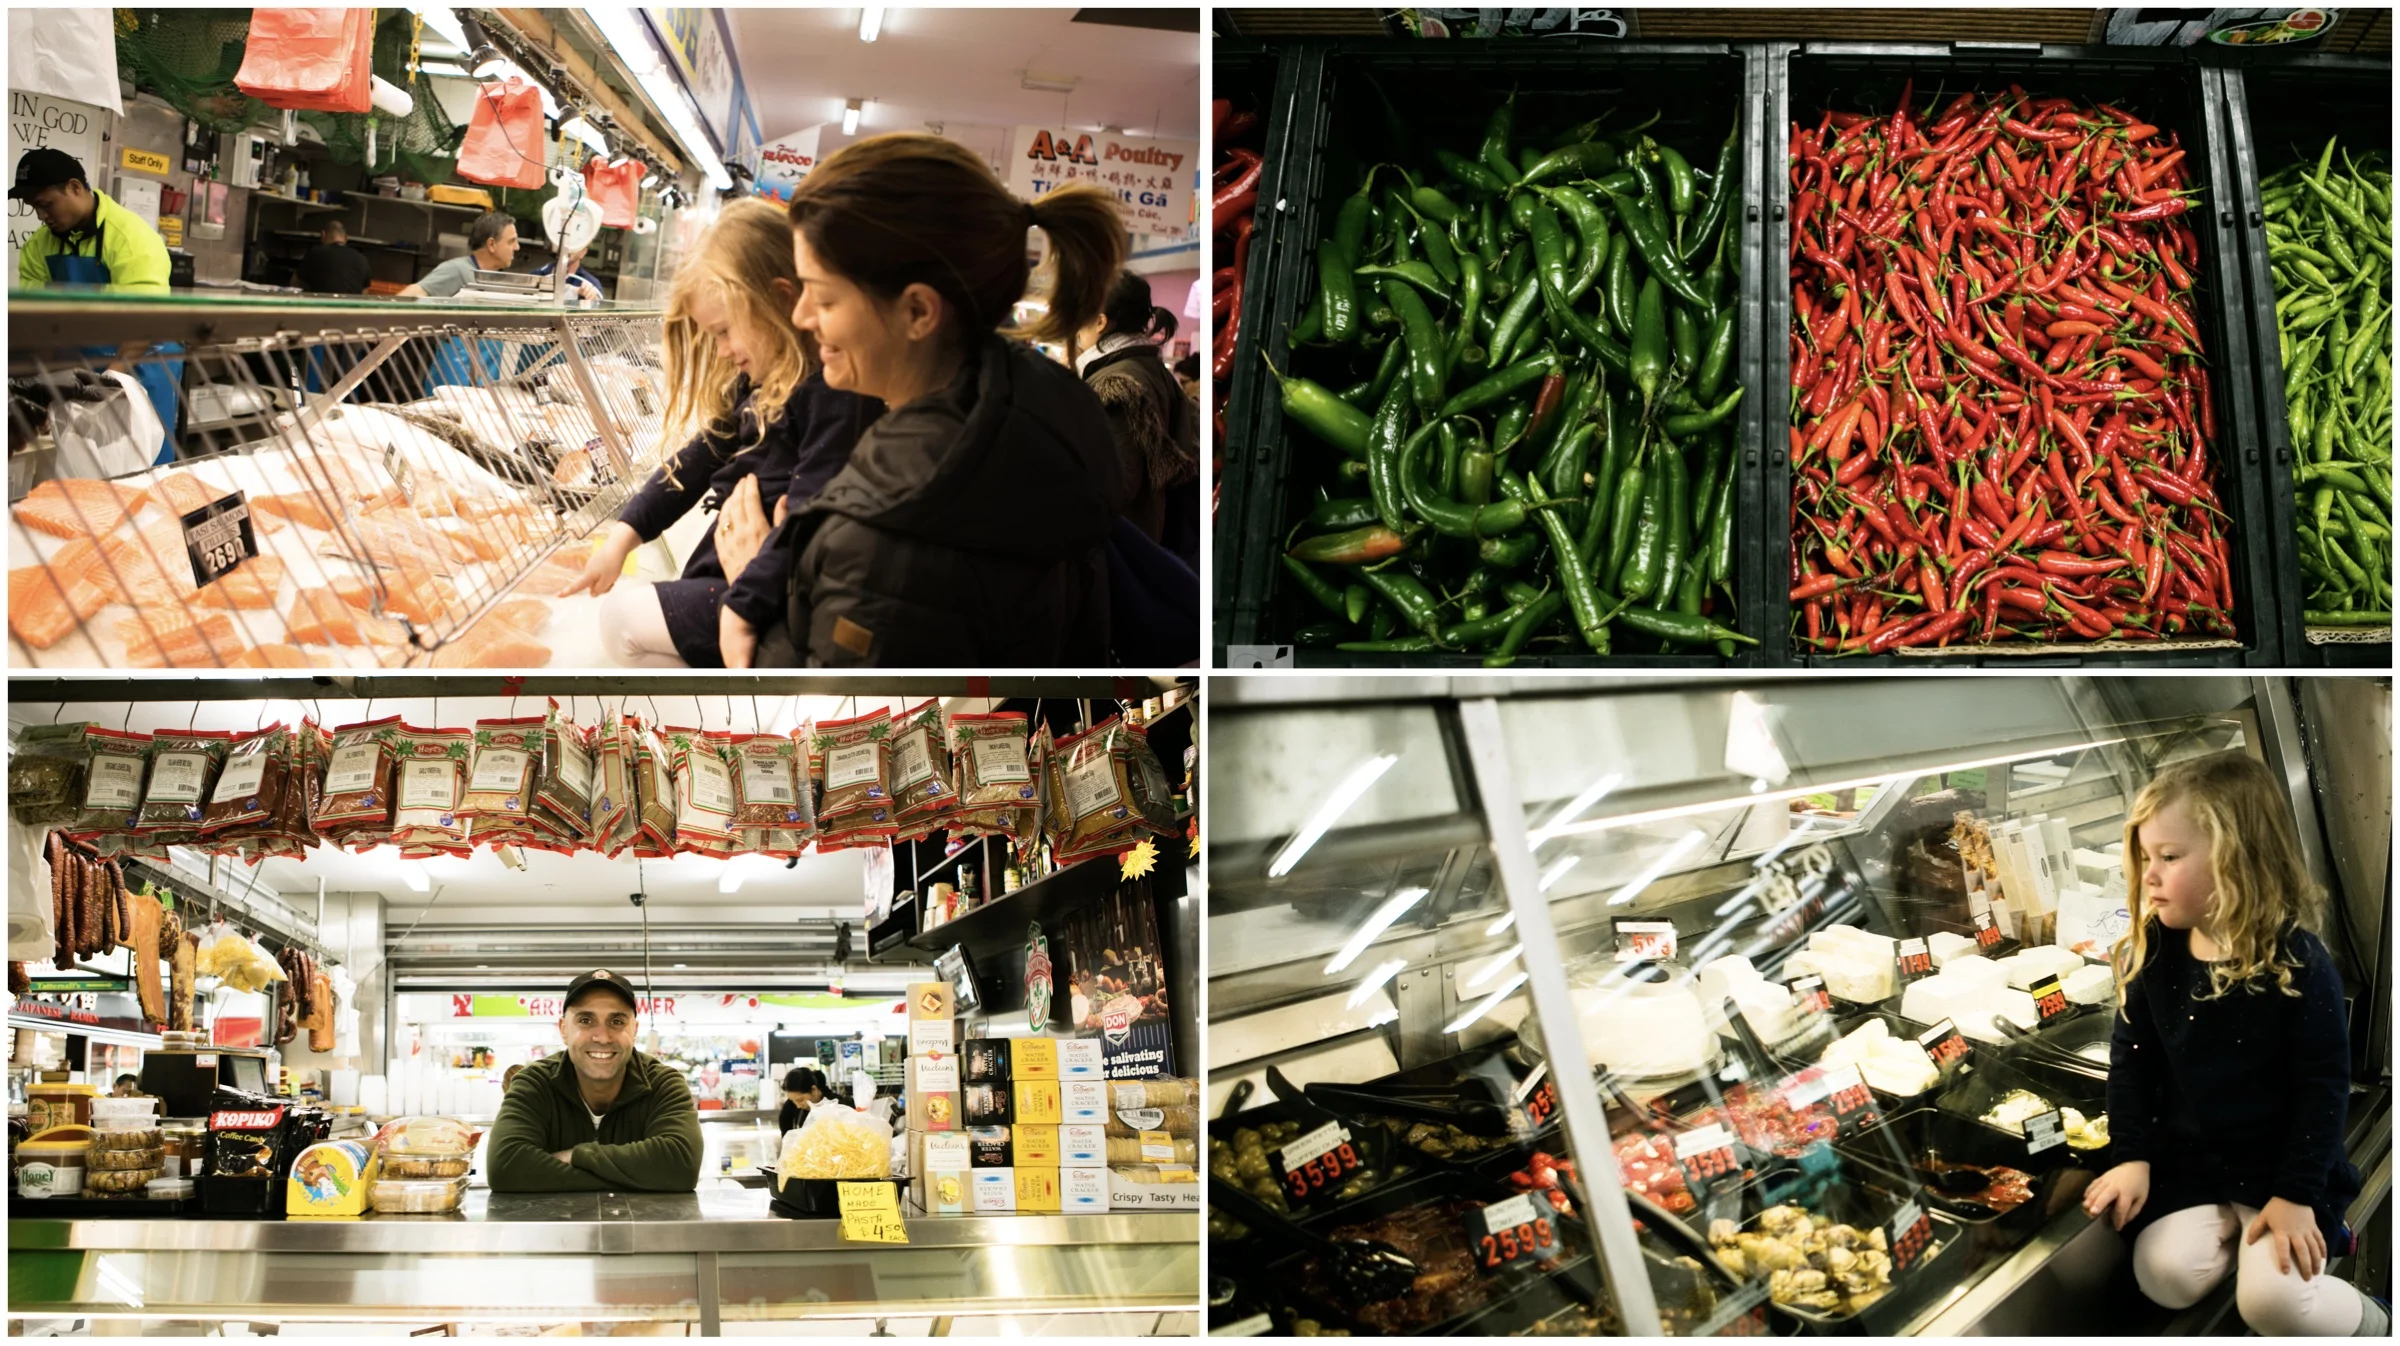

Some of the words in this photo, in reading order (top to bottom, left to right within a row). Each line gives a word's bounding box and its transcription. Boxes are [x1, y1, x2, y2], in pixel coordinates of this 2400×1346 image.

[13, 92, 39, 118] IN
[43, 106, 88, 135] GOD
[13, 123, 50, 148] WE
[763, 150, 813, 167] SEAFOOD
[1028, 130, 1099, 165] A&A
[1104, 141, 1185, 173] Poultry
[128, 153, 147, 166] Staff
[147, 157, 164, 171] Only
[203, 526, 238, 551] FILLES
[204, 537, 246, 575] 2690
[16, 1001, 63, 1019] JAPANESE
[69, 1009, 100, 1024] RAMEN
[529, 998, 563, 1017] AR
[1105, 1014, 1126, 1028] DON
[1110, 1048, 1164, 1066] salivating
[1111, 1064, 1160, 1078] delicious
[216, 1112, 277, 1128] KOPIKO
[219, 1130, 243, 1142] Coffee
[243, 1132, 266, 1146] Candy
[842, 1185, 885, 1198] HOME
[1112, 1193, 1143, 1204] Crispy
[1149, 1193, 1176, 1204] Tasty
[847, 1200, 877, 1208] MADE
[845, 1212, 883, 1225] PASTA
